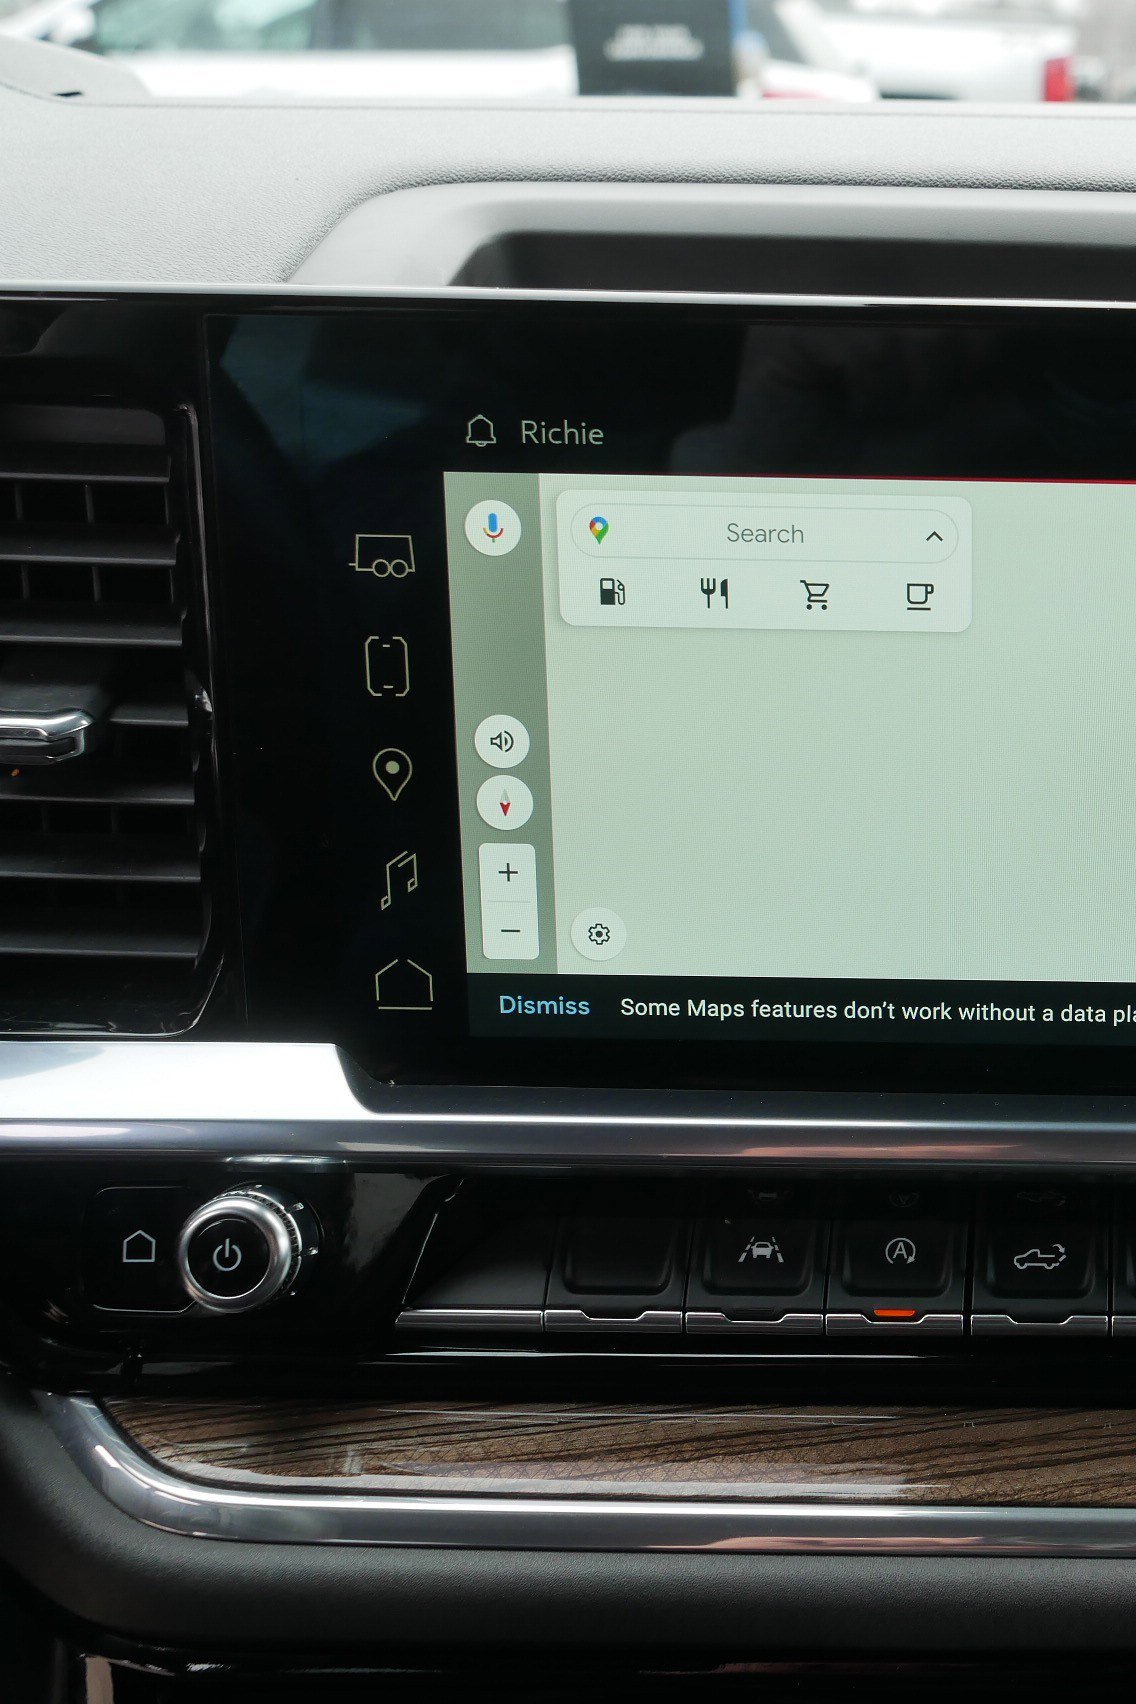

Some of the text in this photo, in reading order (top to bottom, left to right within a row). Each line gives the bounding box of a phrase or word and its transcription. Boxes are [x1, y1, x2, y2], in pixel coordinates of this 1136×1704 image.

[521, 419, 604, 445] Richie
[726, 522, 805, 545] Search
[499, 995, 591, 1016] Dismiss
[620, 997, 681, 1017] Some
[687, 999, 745, 1022] Maps
[750, 999, 838, 1019] features
[901, 1001, 953, 1020] work
[958, 1002, 1036, 1022] without
[1042, 1008, 1054, 1022] a
[1060, 1003, 1106, 1023] data
[892, 1241, 908, 1259] A
